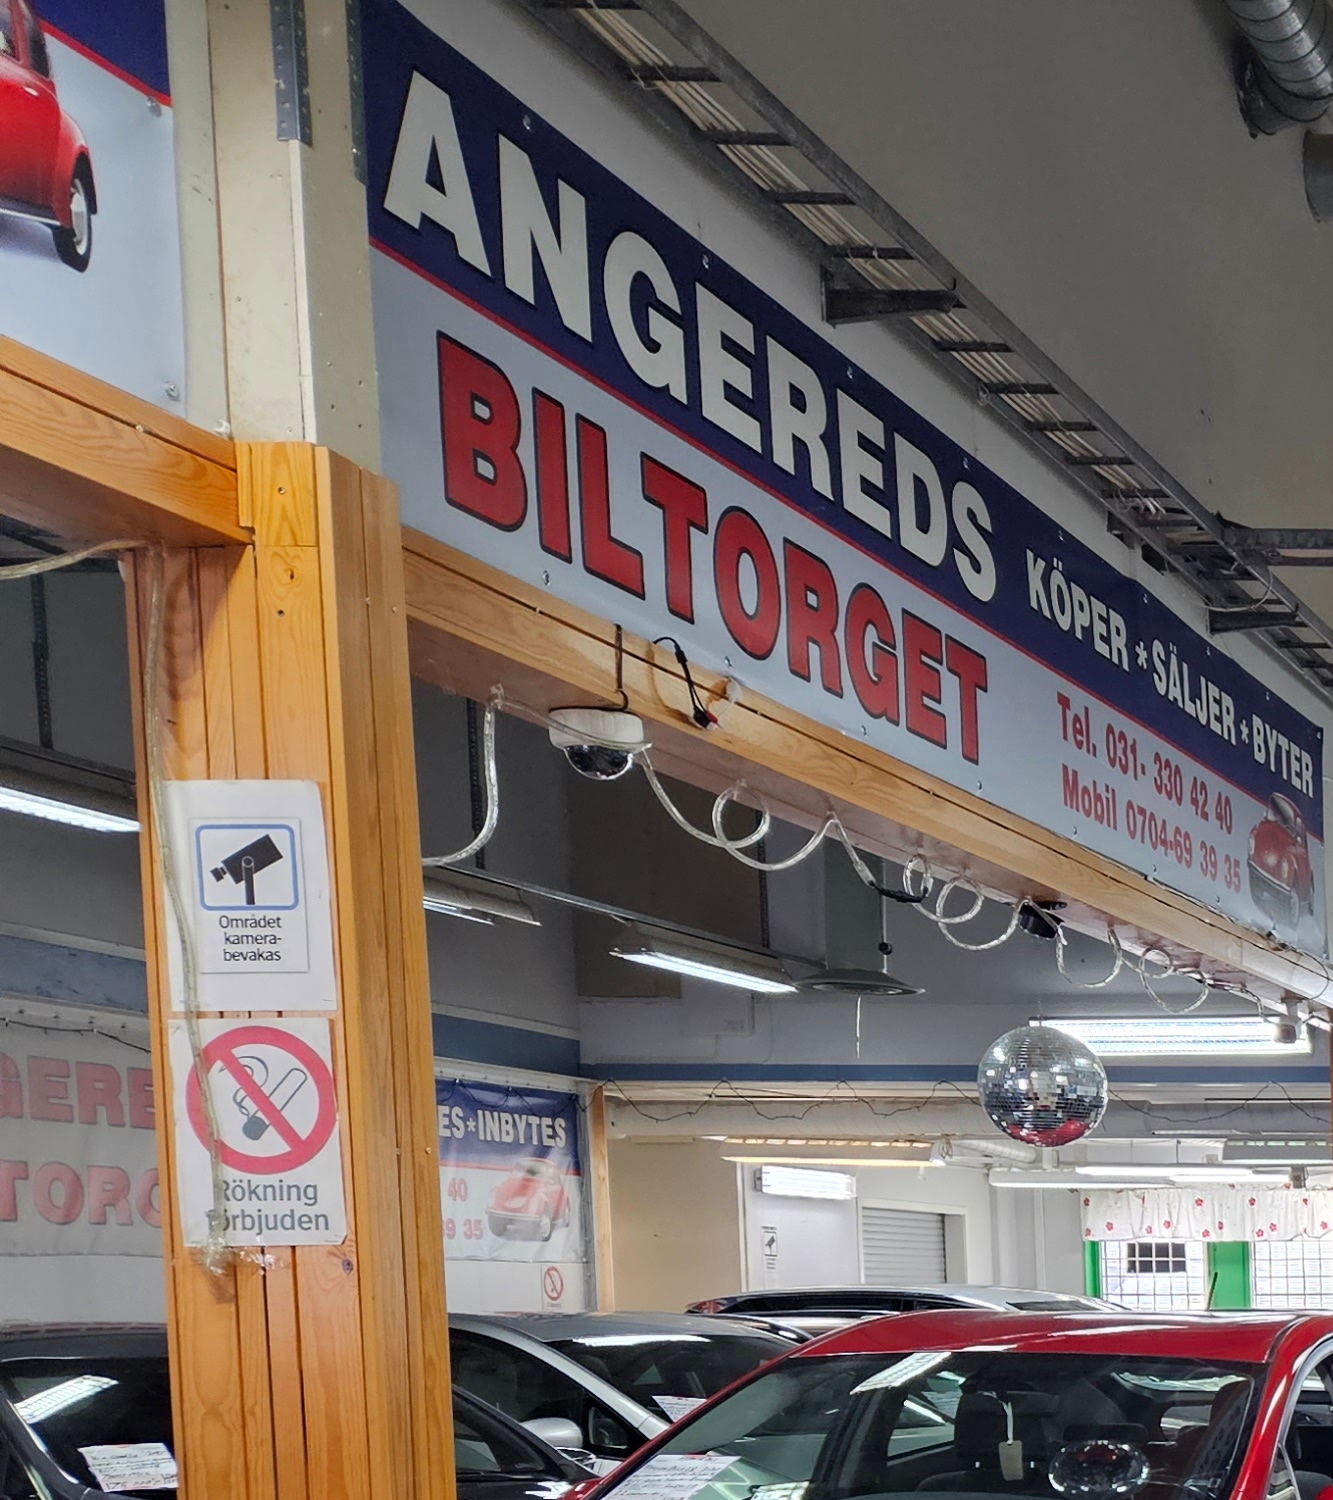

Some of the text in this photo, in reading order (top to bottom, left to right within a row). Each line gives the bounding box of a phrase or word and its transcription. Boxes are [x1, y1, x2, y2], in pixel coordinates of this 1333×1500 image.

[383, 70, 1314, 798] ANGEREDS KÖPER SÄLJER BYTER
[437, 330, 988, 765] BILTORGET
[1057, 691, 1233, 835] Tel. 031- 330 42 40
[1062, 763, 1241, 893] Mobil 0704-69 39 35
[219, 914, 282, 929] Området
[224, 932, 282, 945] kamera-
[223, 948, 282, 962] bevakas
[477, 1110, 566, 1148] INBYTES
[221, 1179, 319, 1207] Rökning
[447, 1177, 469, 1202] 40
[463, 1219, 483, 1240] 35
